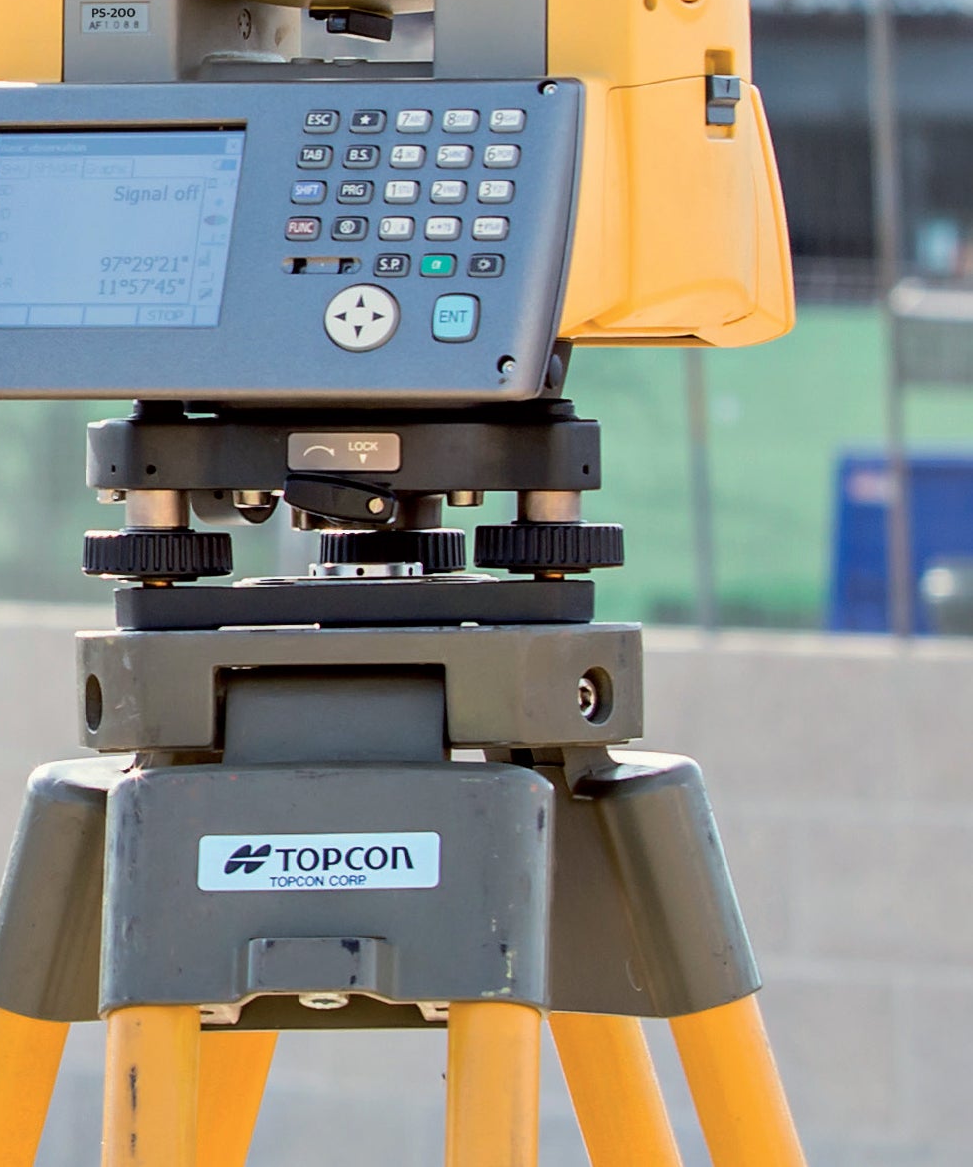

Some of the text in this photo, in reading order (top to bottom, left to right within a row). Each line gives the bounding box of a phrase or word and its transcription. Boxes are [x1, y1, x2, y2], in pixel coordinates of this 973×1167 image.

[91, 8, 136, 18] PS-200
[307, 114, 330, 125] ESC
[303, 149, 323, 161] TAB
[349, 149, 369, 161] B.S.
[113, 184, 201, 205] Signal off
[295, 184, 319, 195] SHIFT
[342, 184, 364, 195] PRG
[288, 222, 314, 233] FUNC
[379, 258, 400, 270] S.P.
[147, 309, 184, 321] STOP
[438, 310, 468, 323] ENT
[348, 441, 378, 451] LOCK
[275, 846, 414, 872] TOPCON
[270, 876, 324, 888] TOPCON
